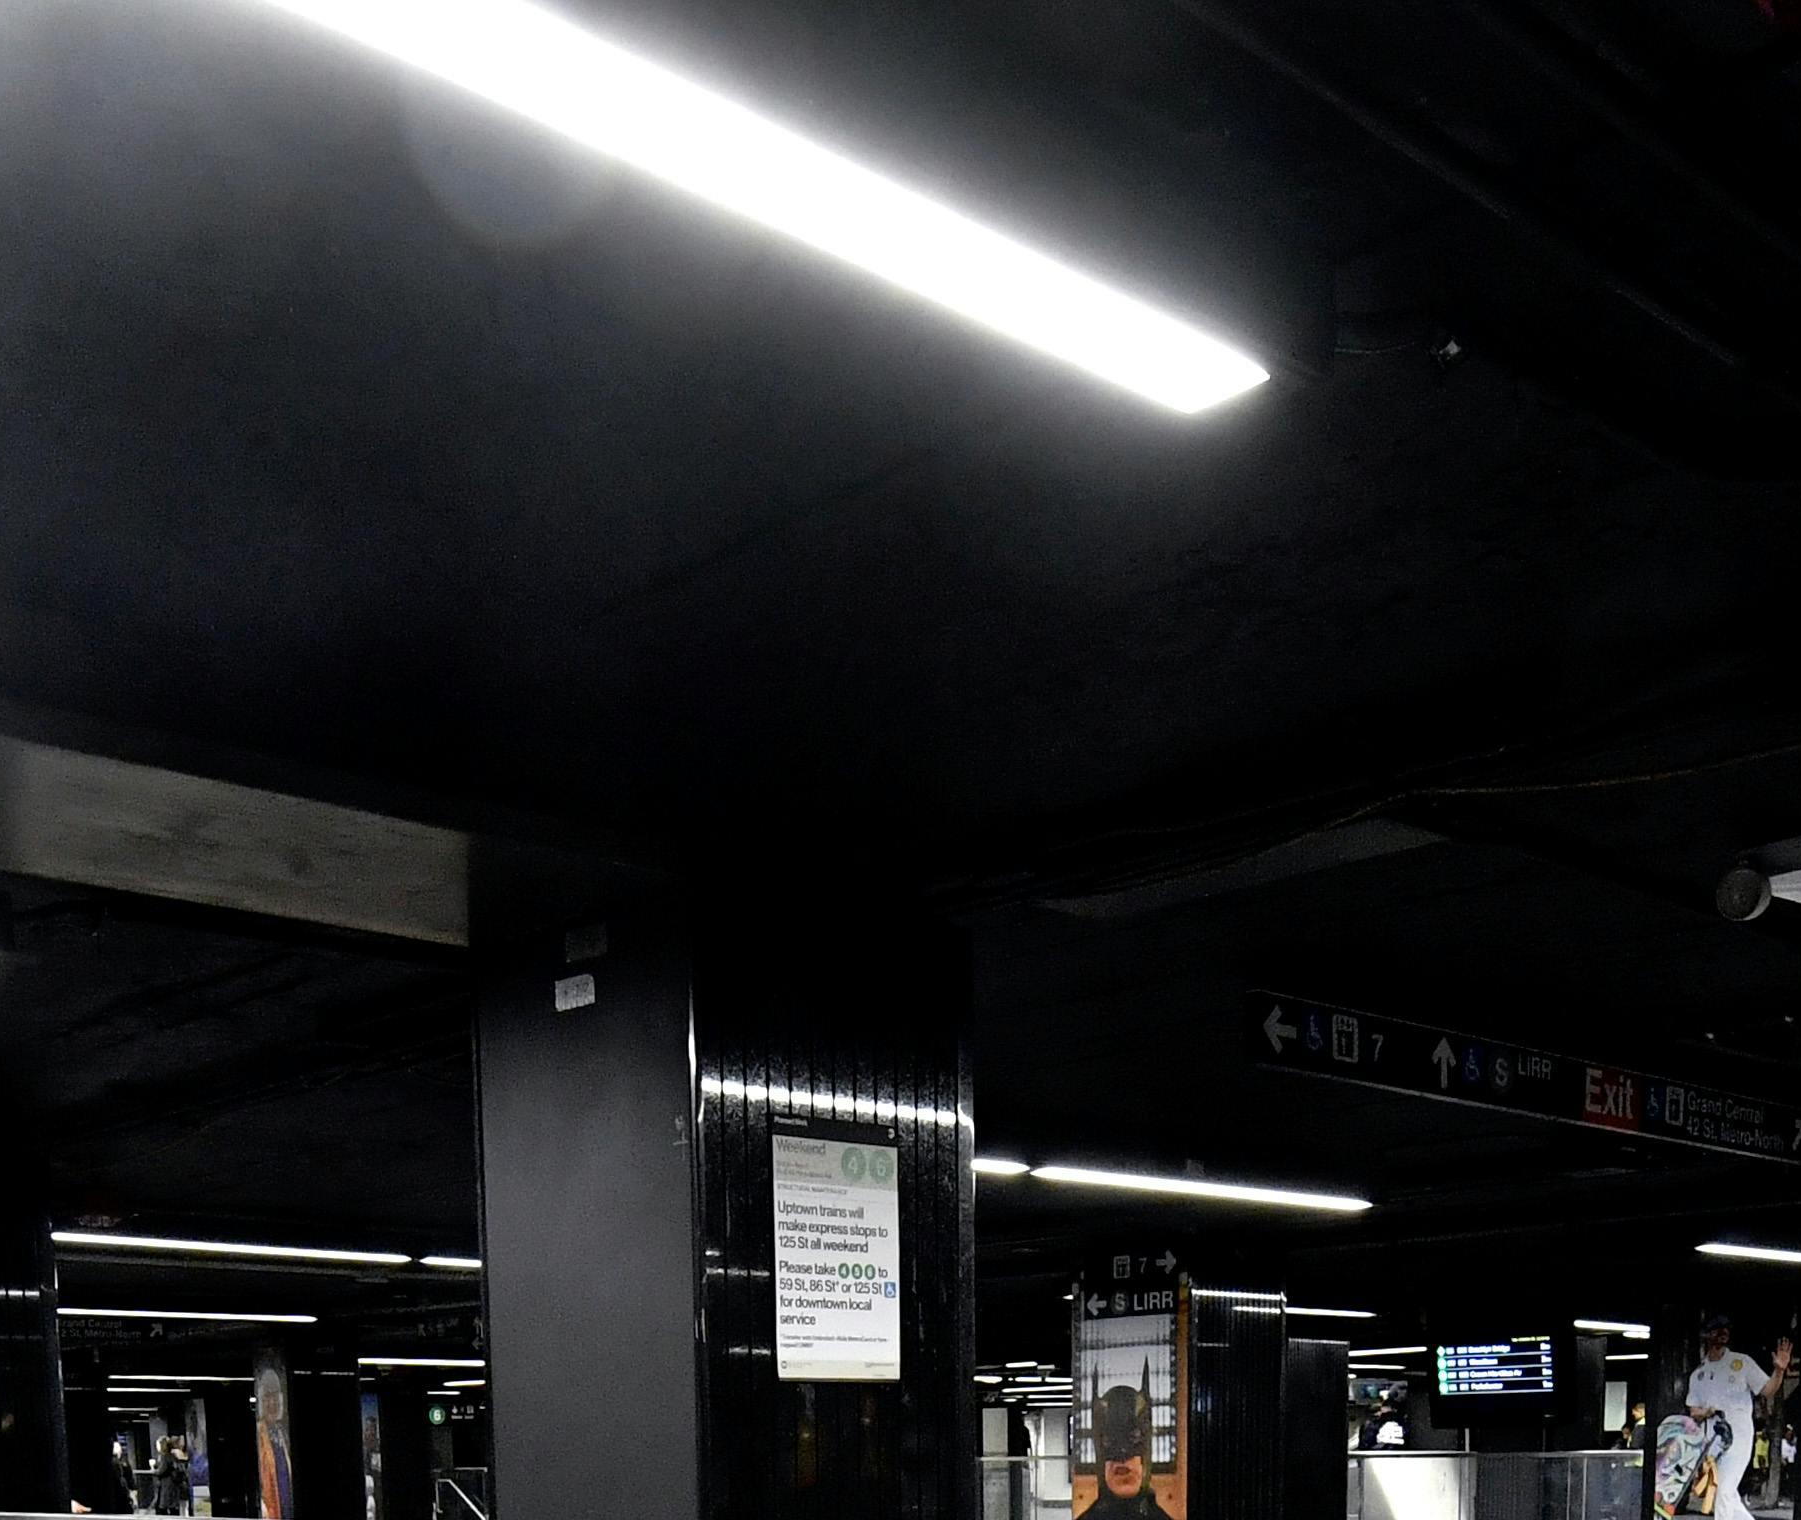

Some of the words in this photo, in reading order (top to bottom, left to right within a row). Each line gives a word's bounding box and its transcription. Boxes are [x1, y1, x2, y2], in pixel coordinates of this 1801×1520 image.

[1371, 1033, 1384, 1063] 7
[1495, 1058, 1509, 1087] S
[1518, 1054, 1552, 1081] LIRR
[1585, 1066, 1634, 1120] Exit
[1687, 1091, 1722, 1117] Grand
[1725, 1100, 1764, 1124] Central
[1721, 1123, 1784, 1152] Metro-North
[778, 1200, 818, 1216] Uptown
[819, 1204, 847, 1218] trains
[848, 1207, 864, 1219] will
[778, 1218, 807, 1233] make
[808, 1222, 848, 1236] express
[850, 1224, 877, 1240] stops
[878, 1226, 888, 1238] to
[779, 1235, 796, 1249] 125
[798, 1236, 809, 1250] St
[810, 1238, 821, 1250] all
[823, 1239, 869, 1253] weekend
[779, 1260, 813, 1275] Please
[814, 1262, 836, 1276] take
[878, 1266, 888, 1278] to
[1139, 1257, 1147, 1273] 7
[779, 1278, 793, 1291] 59
[794, 1278, 809, 1293] St,
[809, 1279, 824, 1292] 86
[841, 1283, 852, 1294] or
[854, 1282, 871, 1295] 125
[871, 1282, 883, 1295] St
[780, 1295, 793, 1307] for
[795, 1296, 847, 1310] downtown
[849, 1298, 872, 1311] local
[1115, 1293, 1126, 1311] S
[1133, 1290, 1174, 1311] LIRR
[780, 1313, 816, 1325] service
